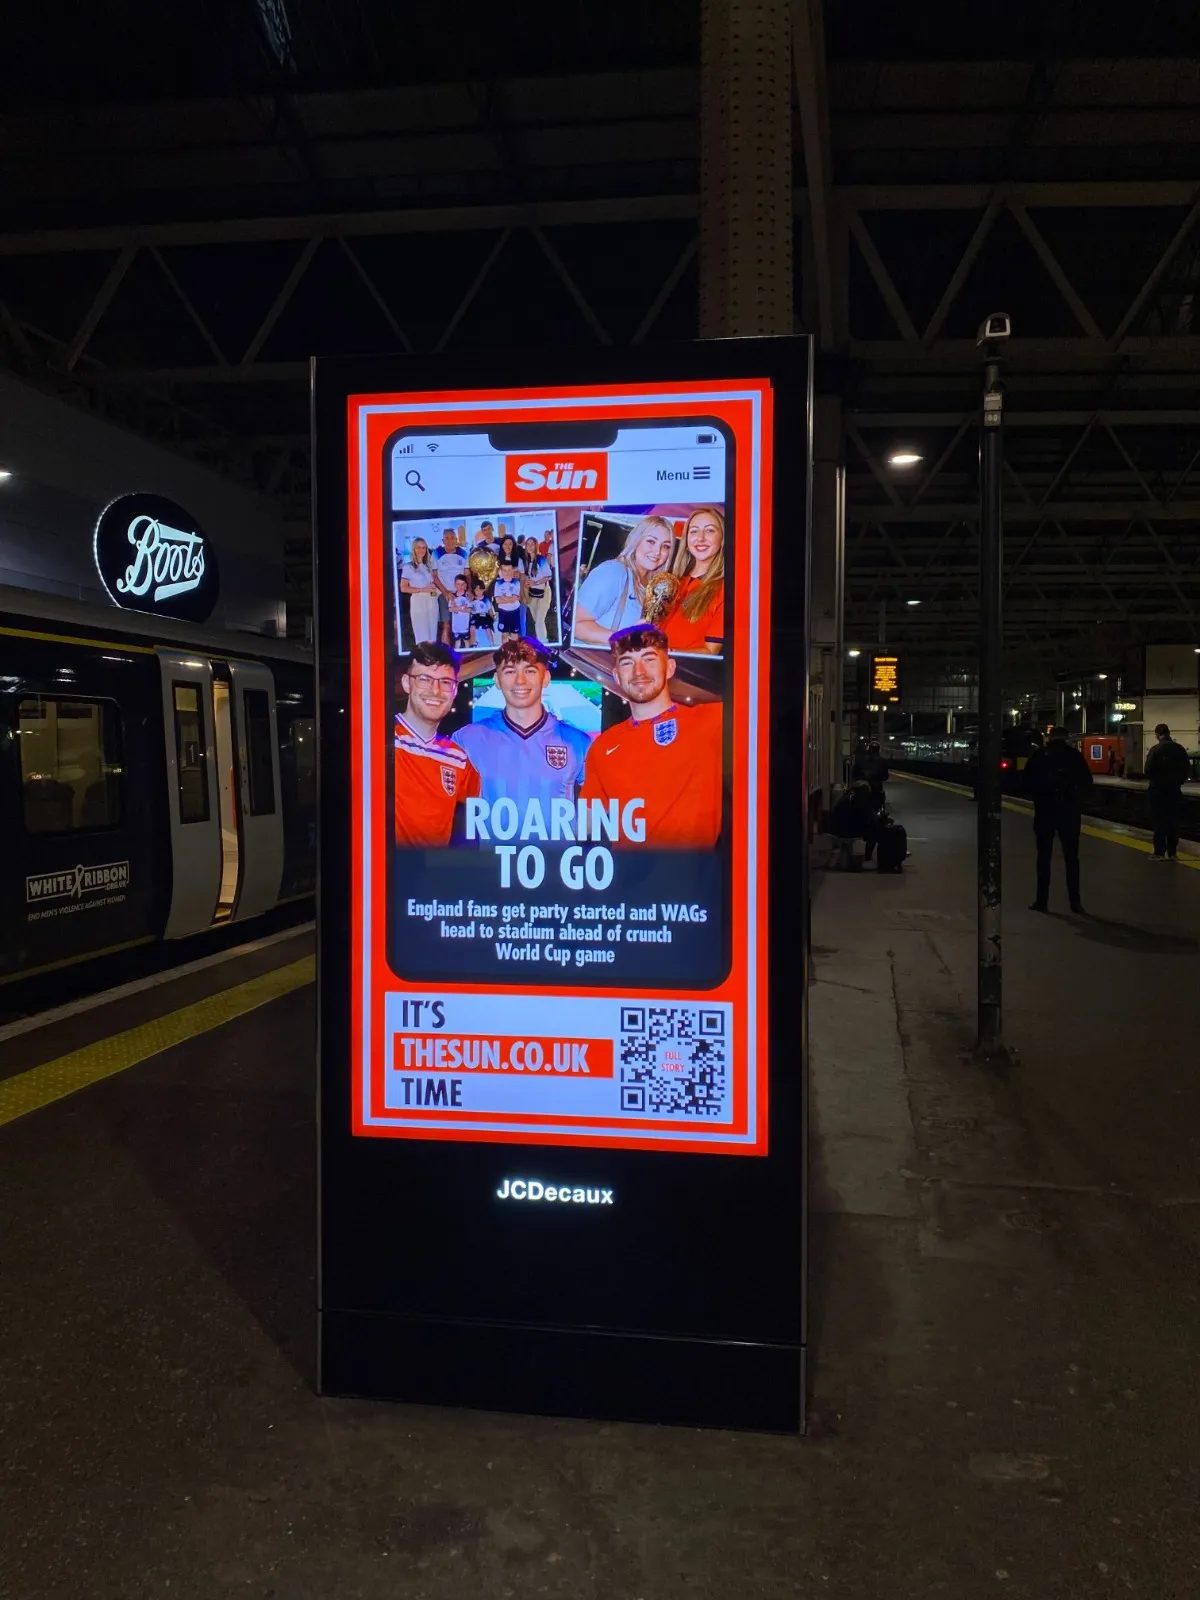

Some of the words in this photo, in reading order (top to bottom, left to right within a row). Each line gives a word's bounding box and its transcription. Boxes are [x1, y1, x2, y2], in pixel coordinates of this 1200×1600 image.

[514, 462, 598, 491] Sun
[554, 462, 574, 471] THE
[656, 469, 690, 481] Menu
[116, 515, 205, 602] Boots
[465, 797, 646, 842] ROARING
[495, 845, 546, 889] TO
[560, 845, 615, 890] GO
[29, 875, 73, 897] WHITE
[84, 865, 127, 887] RIBBON
[27, 912, 41, 922] END
[59, 902, 85, 915] VIOLENCE
[85, 898, 107, 910] AGAINST
[407, 898, 463, 921] England
[467, 900, 498, 917] fans
[502, 903, 526, 923] get
[530, 903, 569, 924] party
[573, 903, 625, 920] started
[629, 903, 657, 921] and
[661, 904, 708, 922] WAGs
[440, 921, 475, 938] head
[480, 923, 494, 939] to
[498, 922, 555, 940] stadium
[559, 923, 602, 941] ahead
[607, 924, 622, 942] of
[626, 925, 672, 943] crunch
[495, 942, 540, 961] World
[544, 943, 571, 967] Cup
[575, 949, 615, 967] game
[402, 999, 446, 1029] IT'S
[400, 1038, 591, 1074] THESUN.CO.UK
[661, 1063, 685, 1072] STORY
[664, 1051, 682, 1060] FULL
[401, 1077, 463, 1107] TIME
[496, 1179, 614, 1205] JCDecaux
